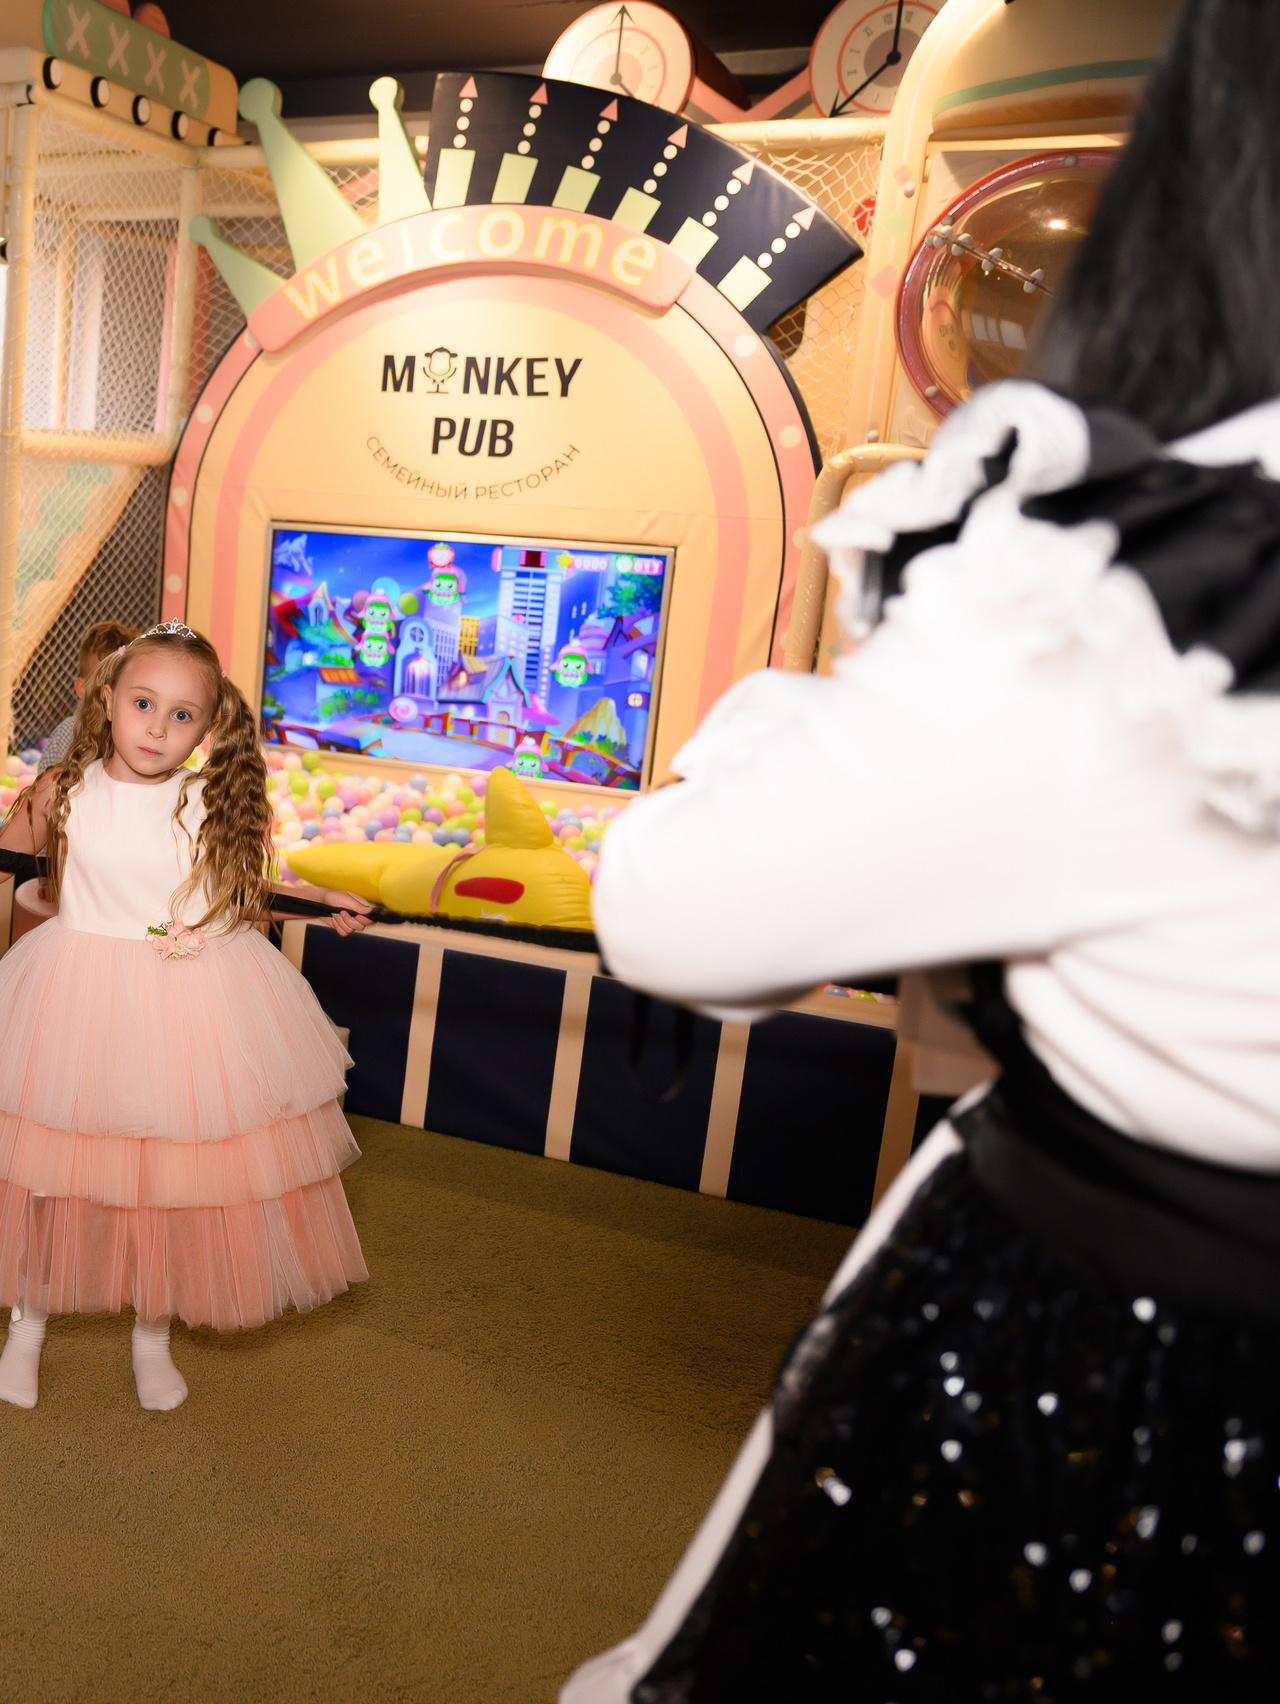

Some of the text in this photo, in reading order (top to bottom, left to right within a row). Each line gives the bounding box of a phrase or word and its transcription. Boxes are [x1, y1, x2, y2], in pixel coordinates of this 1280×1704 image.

[283, 207, 658, 322] welcome
[366, 435, 581, 501] СЕМЕЙНЫЙ РЕСТОРАН
[431, 416, 515, 459] PUB
